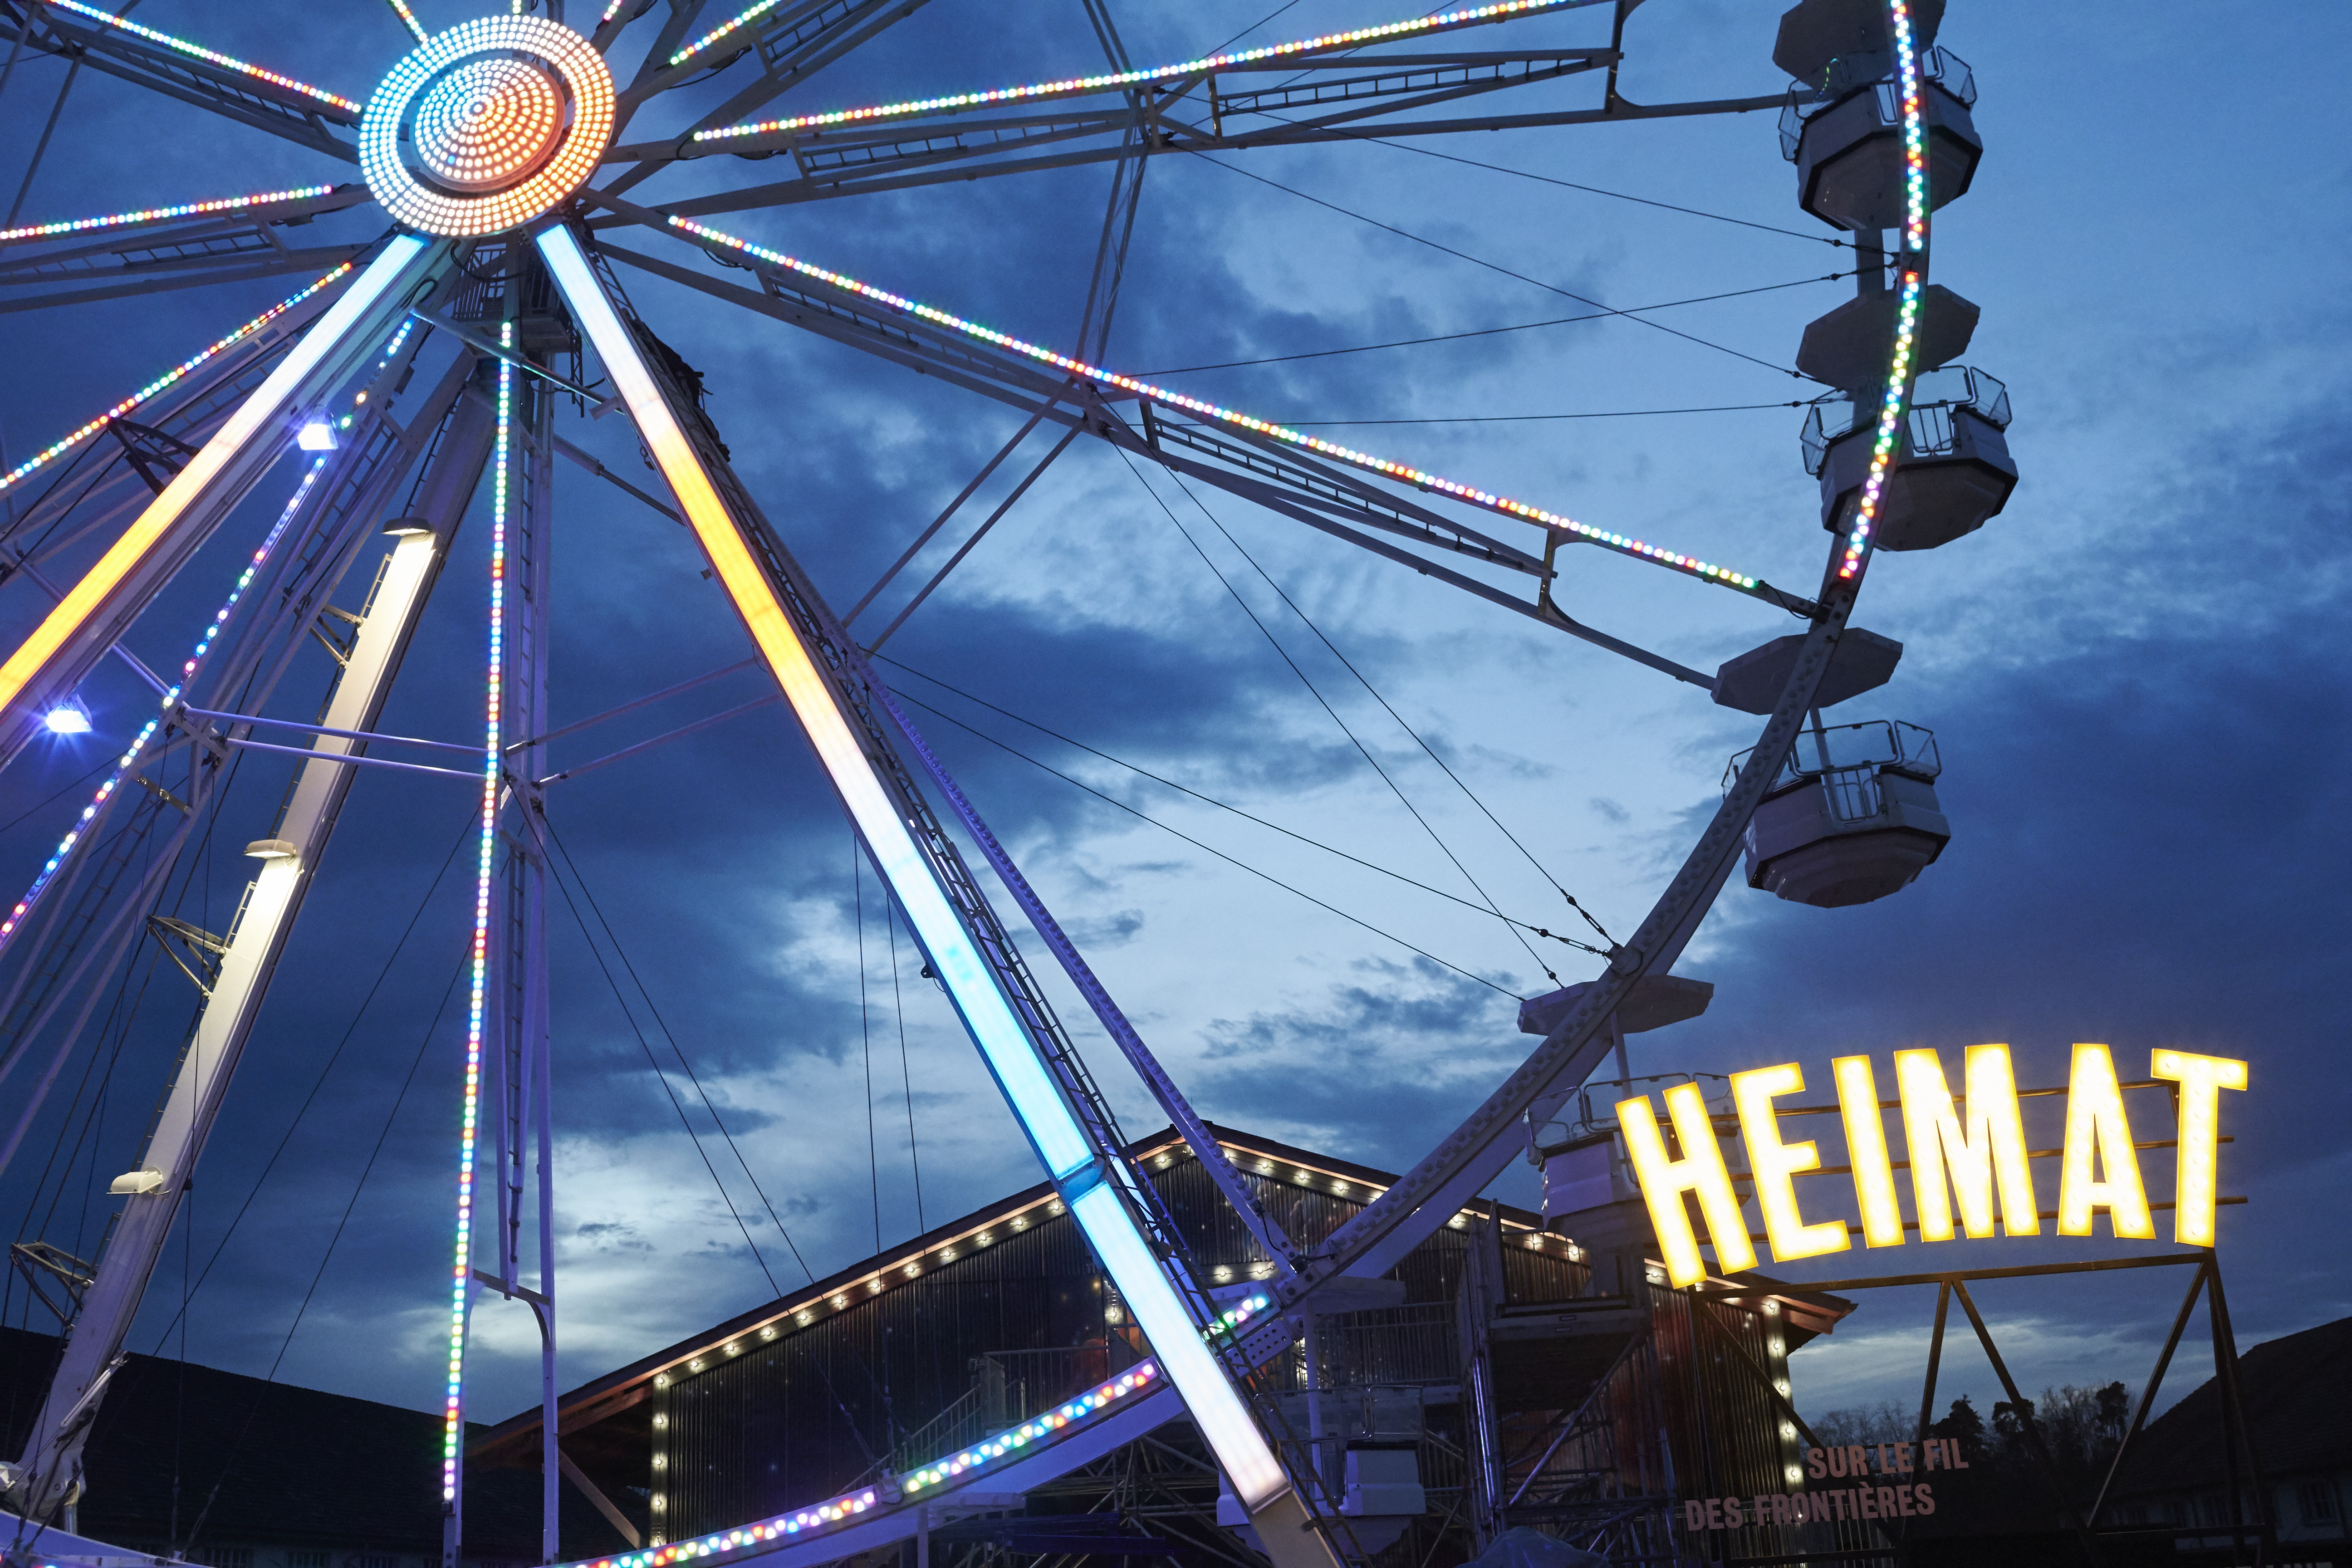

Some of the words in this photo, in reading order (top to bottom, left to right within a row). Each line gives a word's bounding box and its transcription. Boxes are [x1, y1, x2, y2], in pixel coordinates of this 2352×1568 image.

[1614, 1043, 2248, 1289] HEIMAT
[1807, 1445, 1869, 1479] SUR
[1877, 1441, 1914, 1474] LE
[1923, 1438, 1970, 1471] FIL
[1685, 1496, 1744, 1531] DES
[1754, 1481, 1936, 1527] FRONTIÈRES
